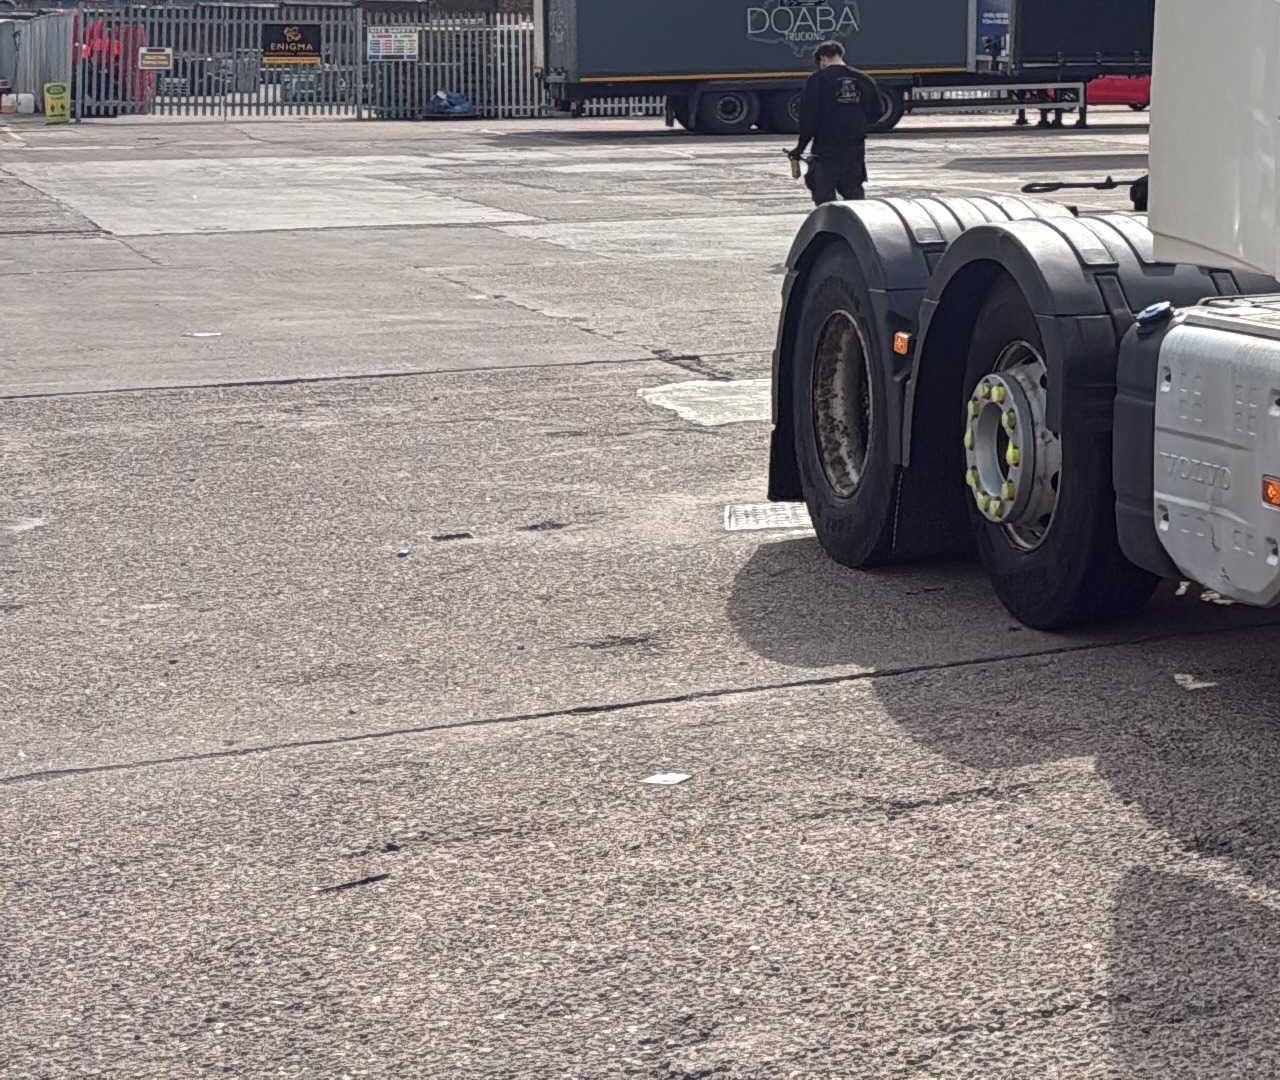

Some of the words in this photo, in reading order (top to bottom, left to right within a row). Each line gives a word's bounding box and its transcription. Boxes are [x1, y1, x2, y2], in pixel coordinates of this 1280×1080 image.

[747, 5, 860, 34] DOABA
[784, 31, 826, 41] TRUCKING
[271, 42, 314, 51] ENIGMA
[1160, 451, 1231, 491] VOLVO
